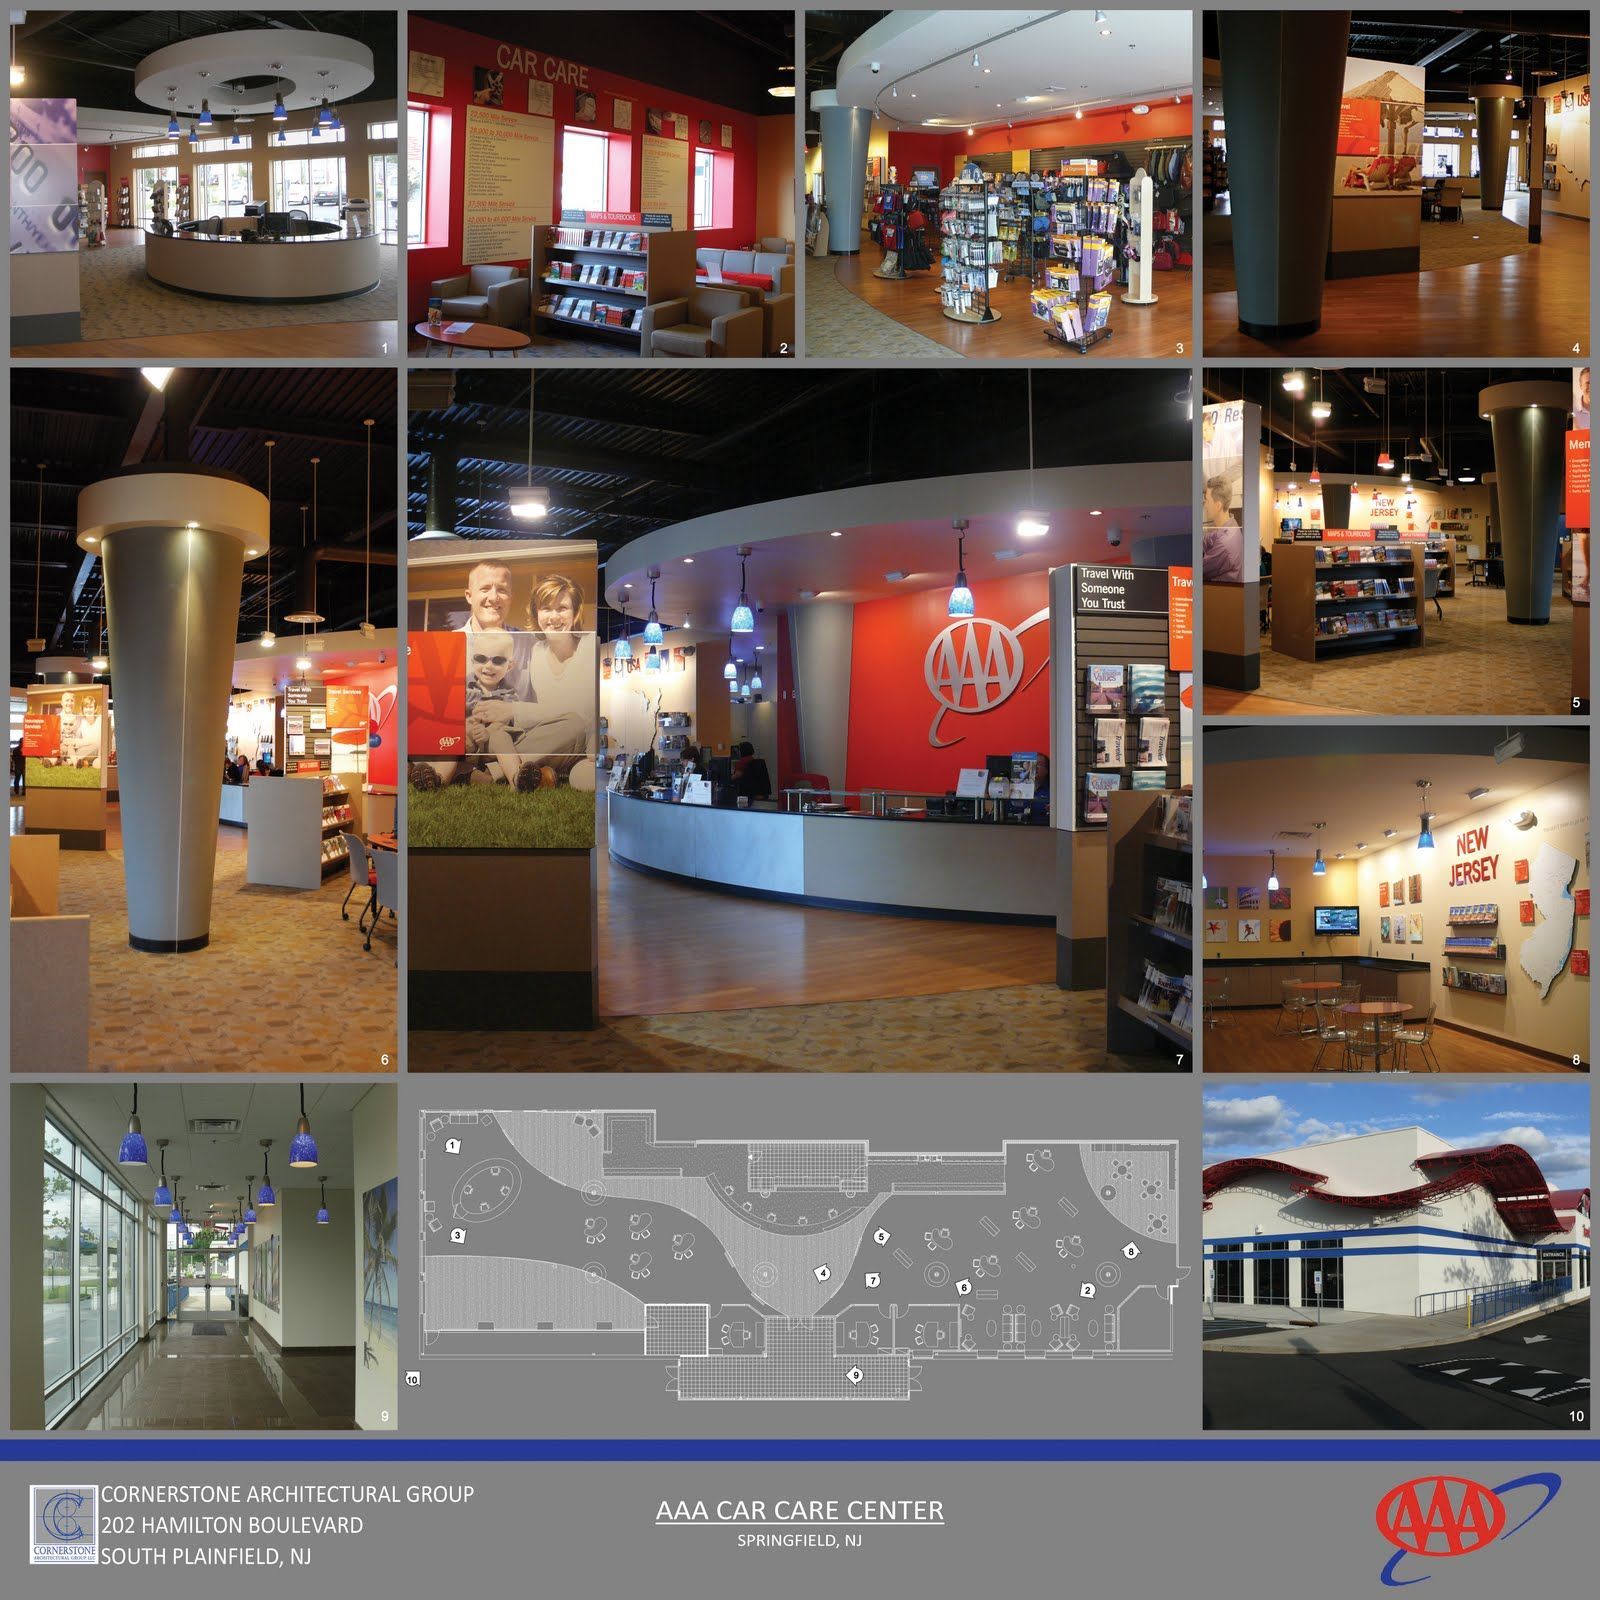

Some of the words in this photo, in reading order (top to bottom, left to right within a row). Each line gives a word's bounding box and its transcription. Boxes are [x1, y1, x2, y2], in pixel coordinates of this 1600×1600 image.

[496, 44, 537, 76] CAR
[543, 57, 589, 88] CARE
[1375, 498, 1395, 507] NEW
[1370, 508, 1399, 517] JERSEY
[1081, 567, 1109, 579] Travel
[1111, 569, 1134, 580] With
[1081, 582, 1125, 595] Someone
[1081, 597, 1099, 608] You
[1101, 598, 1125, 609] Trust
[926, 618, 1022, 712] AAA
[1457, 825, 1489, 857] NEW
[1449, 854, 1500, 888] JERSEY
